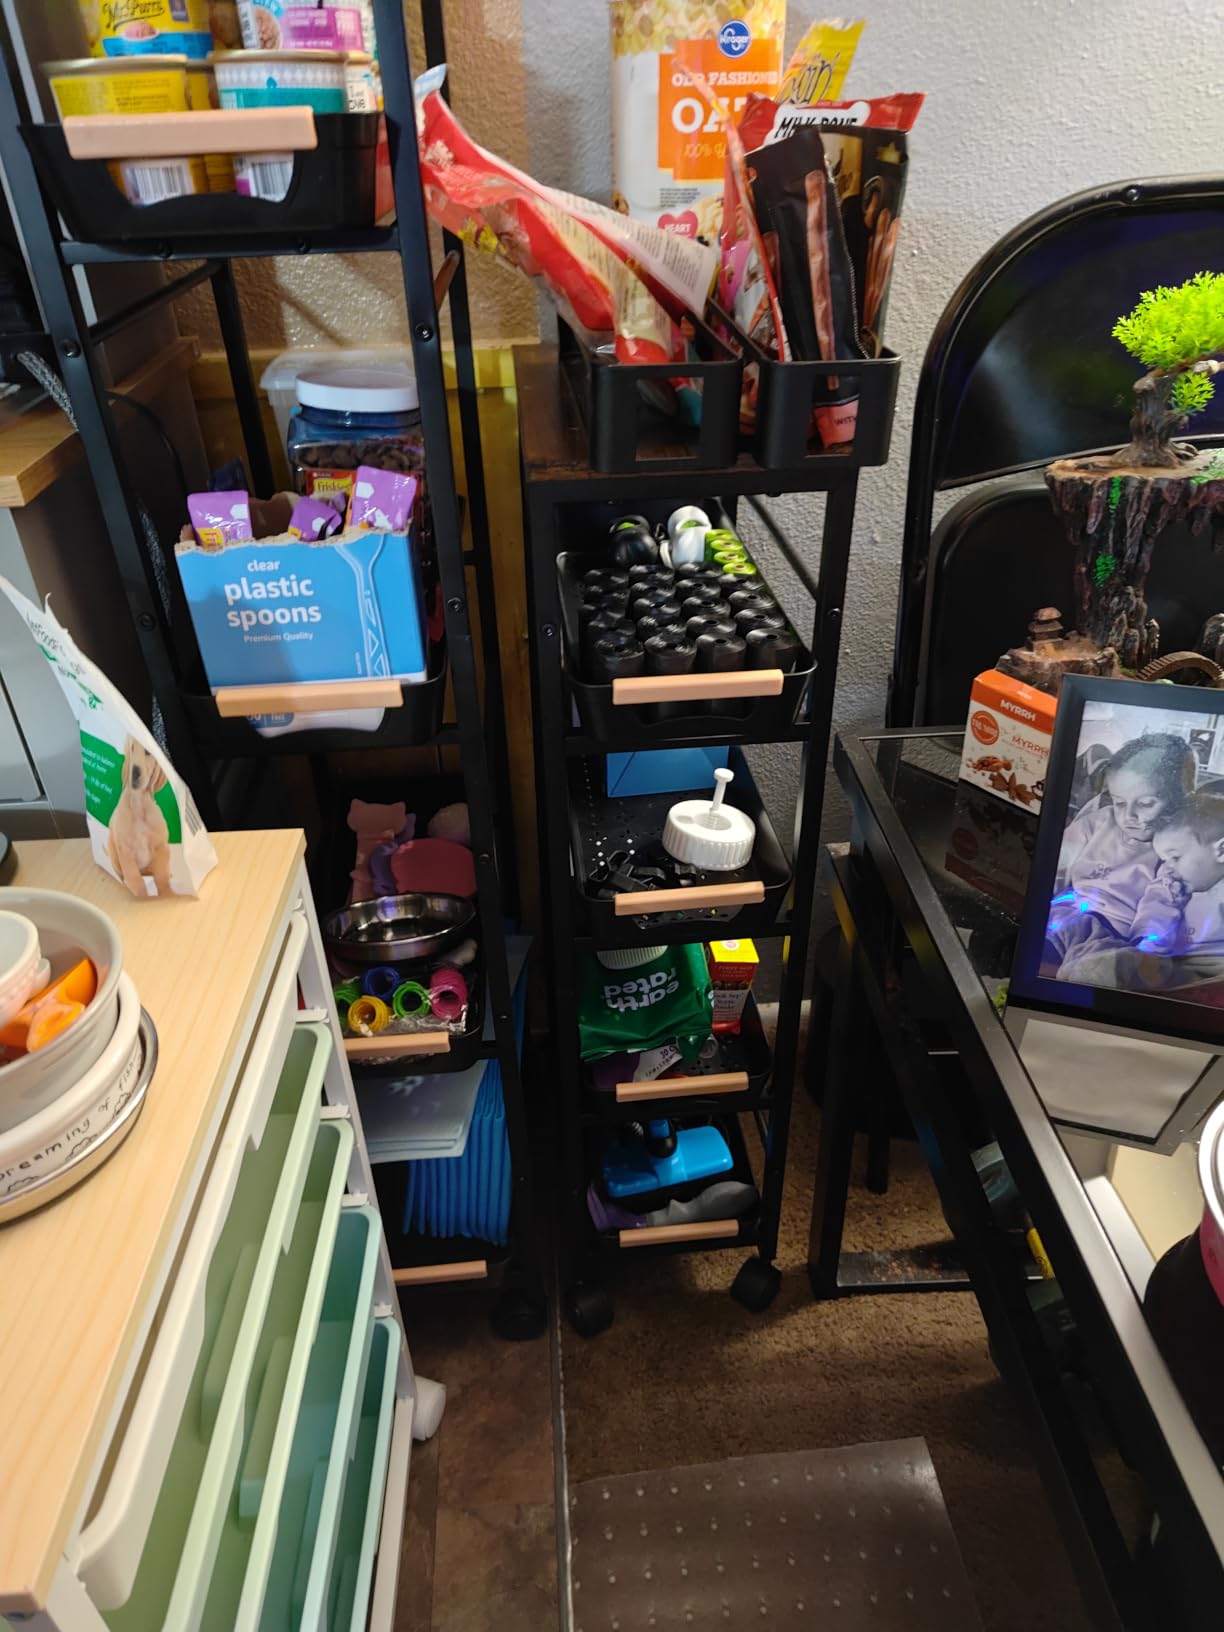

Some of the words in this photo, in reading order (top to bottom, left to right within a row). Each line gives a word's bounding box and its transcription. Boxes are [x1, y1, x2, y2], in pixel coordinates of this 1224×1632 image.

[246, 559, 281, 573] clear
[223, 573, 315, 607] plastic
[226, 605, 323, 633] spoons
[243, 632, 282, 644] Premium
[282, 631, 314, 643] Quality
[999, 699, 1037, 722] MYRRH
[1011, 735, 1049, 758] MYRRH
[603, 967, 678, 998] rated
[605, 980, 680, 1013] earth
